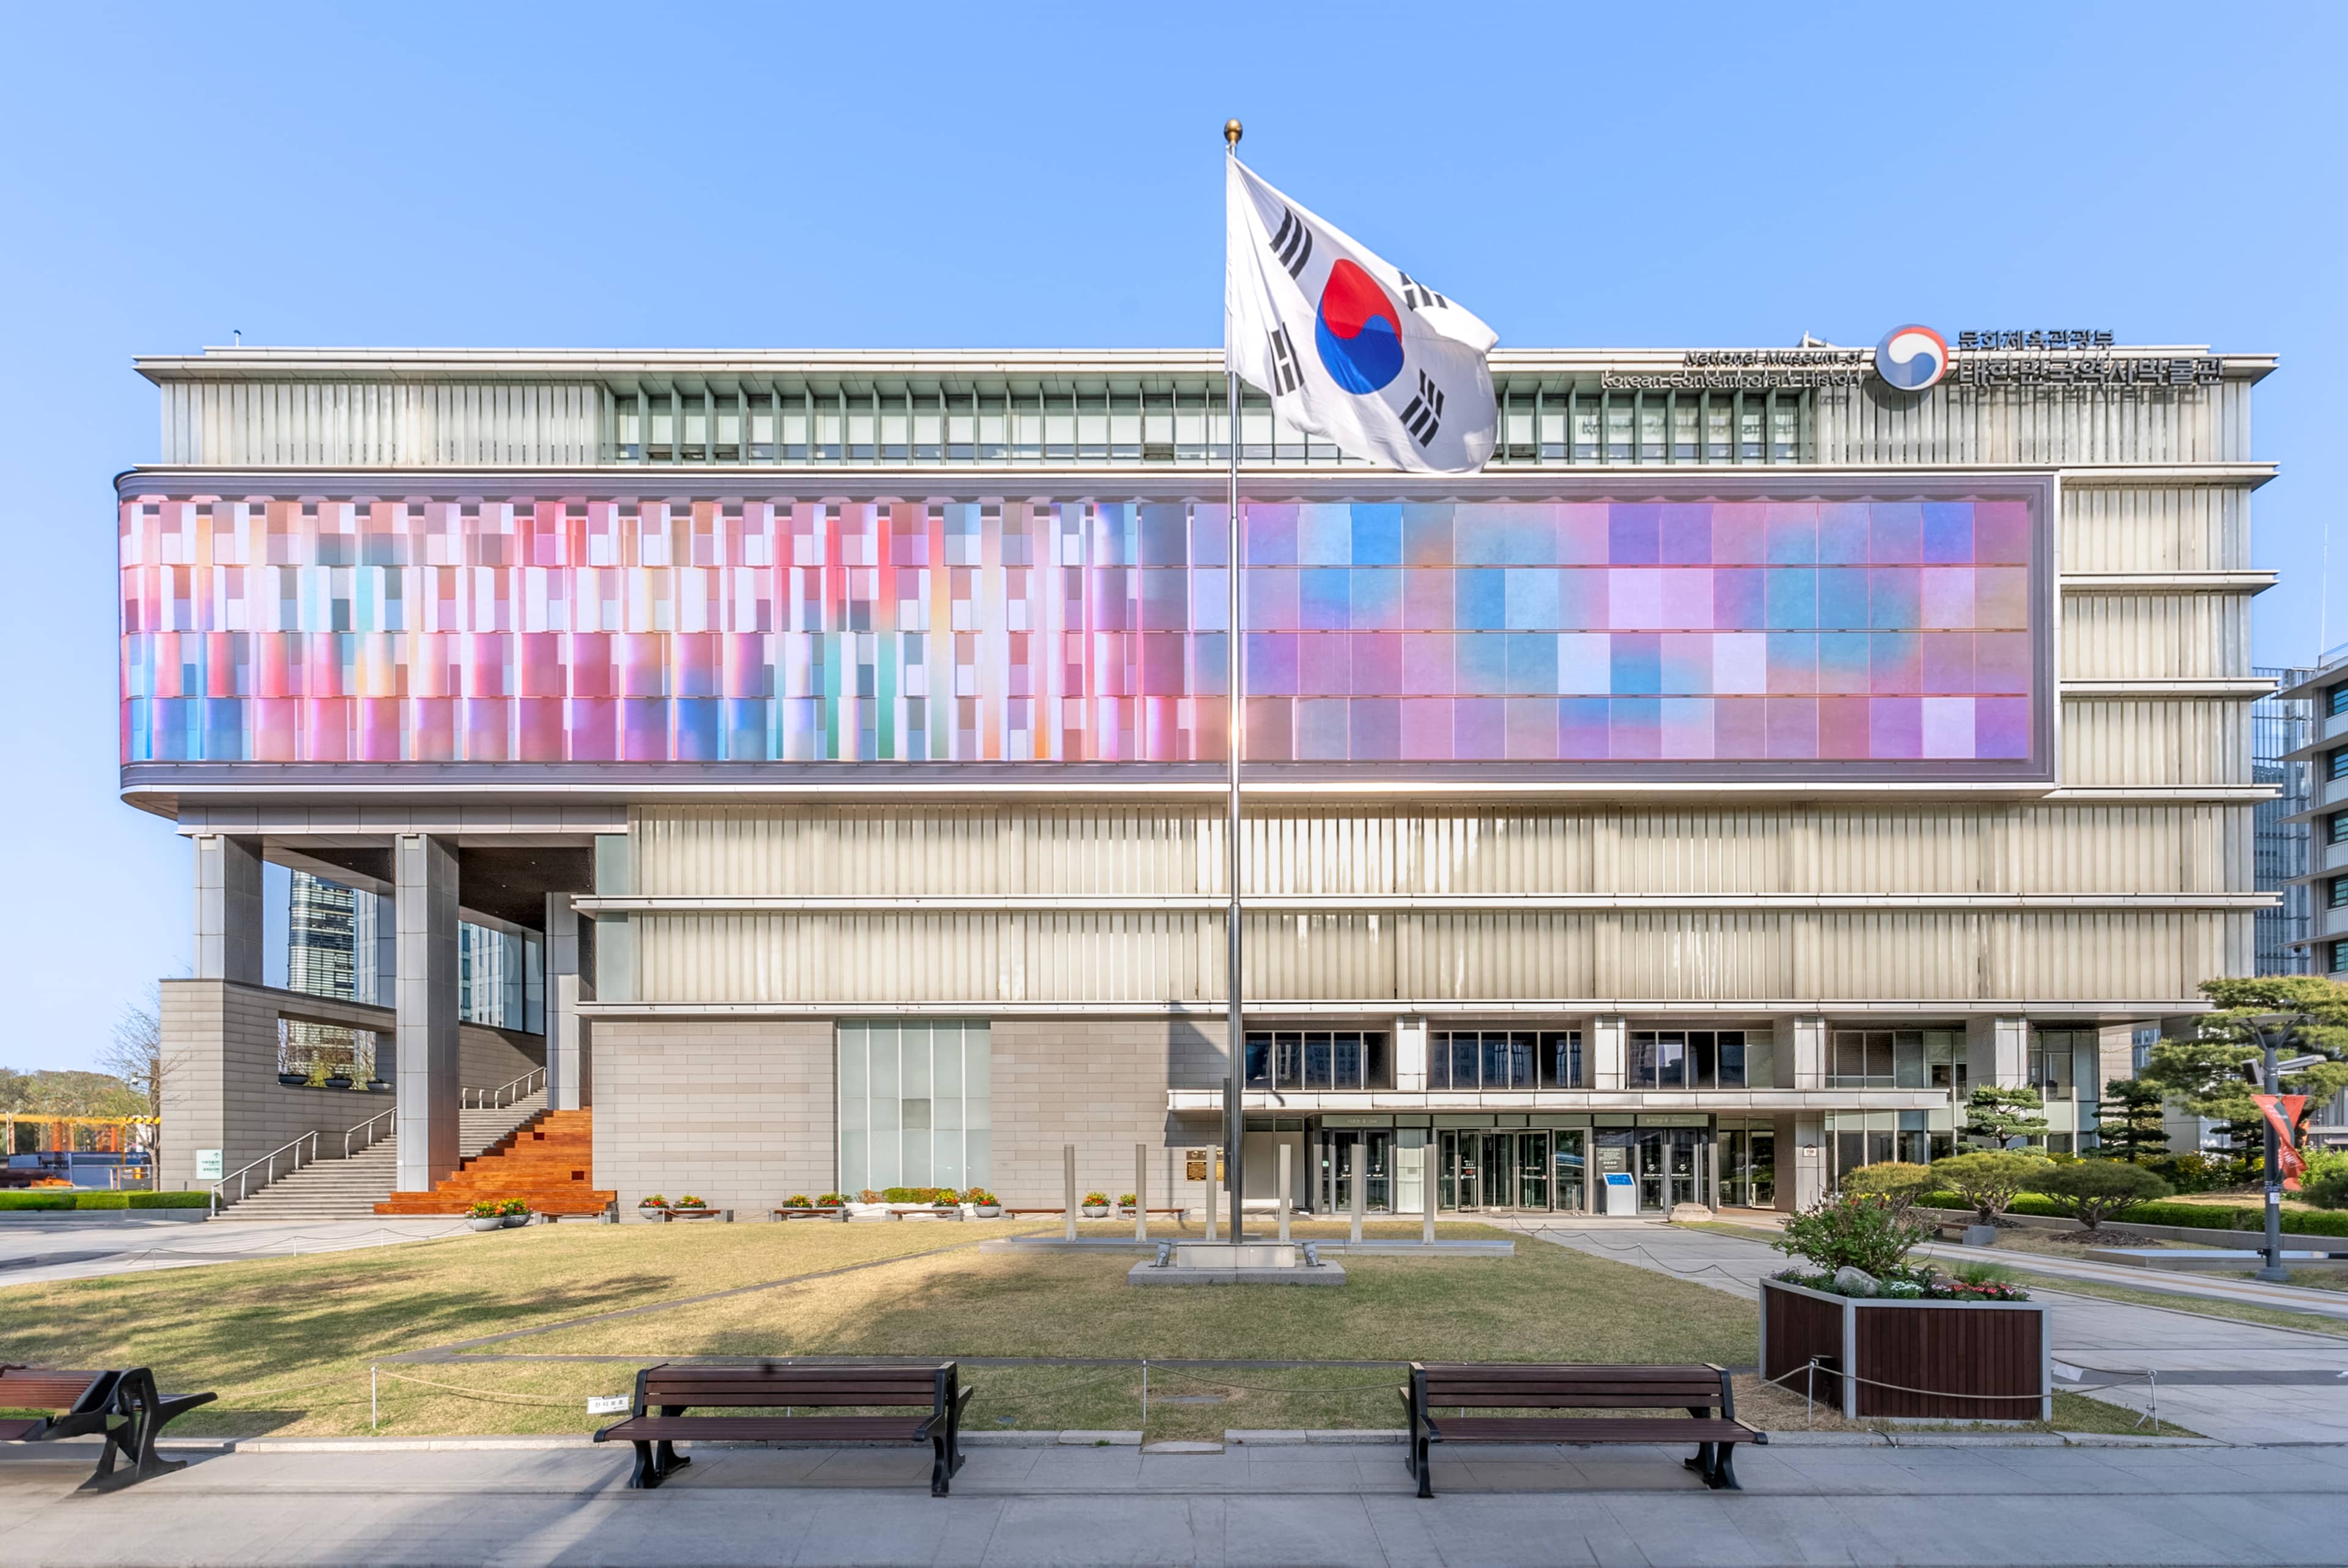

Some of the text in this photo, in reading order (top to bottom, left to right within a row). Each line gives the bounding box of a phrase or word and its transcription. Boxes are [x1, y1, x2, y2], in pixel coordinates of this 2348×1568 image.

[1959, 329, 2114, 350] 문화체육관광부
[1685, 349, 1864, 366] National Museum of
[1601, 372, 1865, 389] Korean Contemporary History
[1959, 357, 2224, 386] 대한민국역사박물관
